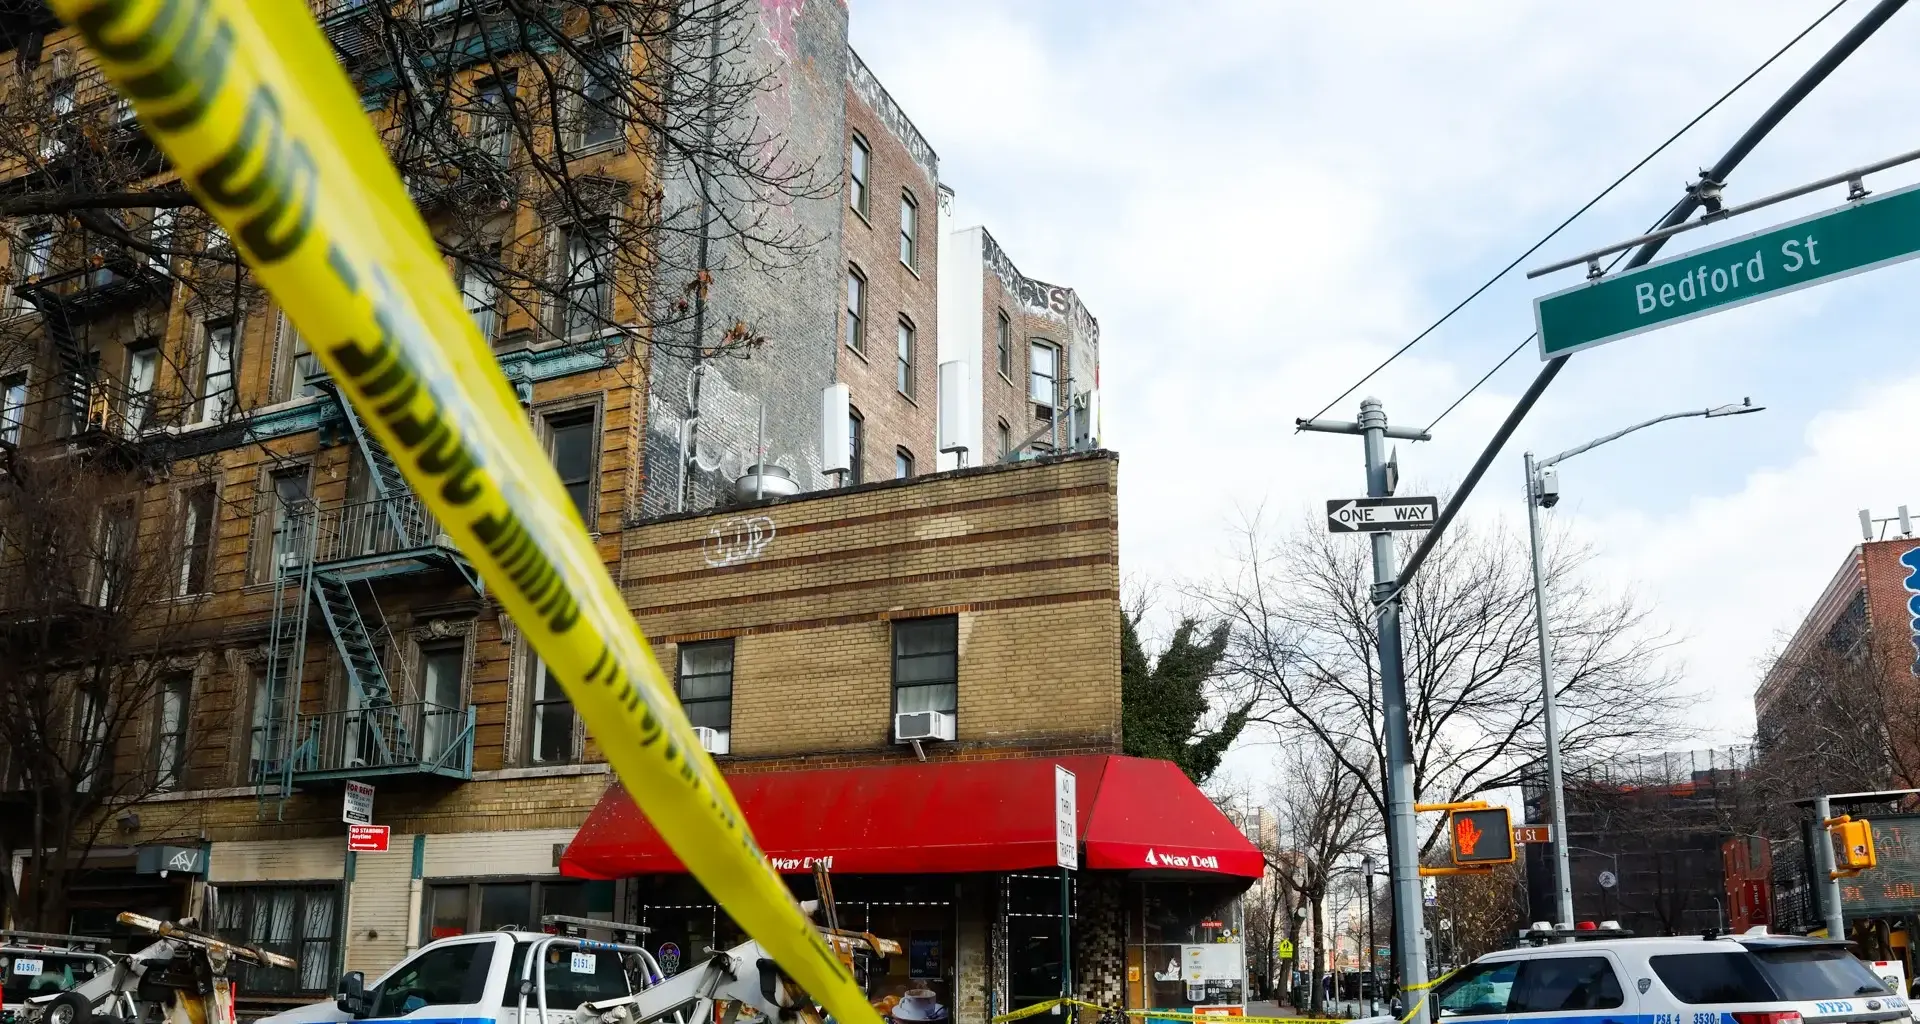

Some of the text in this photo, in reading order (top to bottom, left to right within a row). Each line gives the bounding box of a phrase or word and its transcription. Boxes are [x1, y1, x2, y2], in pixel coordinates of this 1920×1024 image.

[1635, 234, 1821, 315] Bedford St
[1339, 506, 1428, 523] ONE WAY
[347, 783, 373, 796] FOR RENT
[1062, 779, 1070, 794] NO
[1061, 798, 1072, 815] THRU
[1060, 820, 1073, 838] TRUCK
[1526, 829, 1537, 841] St
[771, 857, 803, 870] Way
[1145, 847, 1219, 869] 4 Way Deli
[17, 962, 35, 972] 6150
[573, 958, 589, 969] 6151
[1815, 1000, 1853, 1014] NYPD
[1656, 1013, 1671, 1024] PSA
[1674, 1013, 1680, 1024] 4
[1693, 1012, 1716, 1024] 3530
